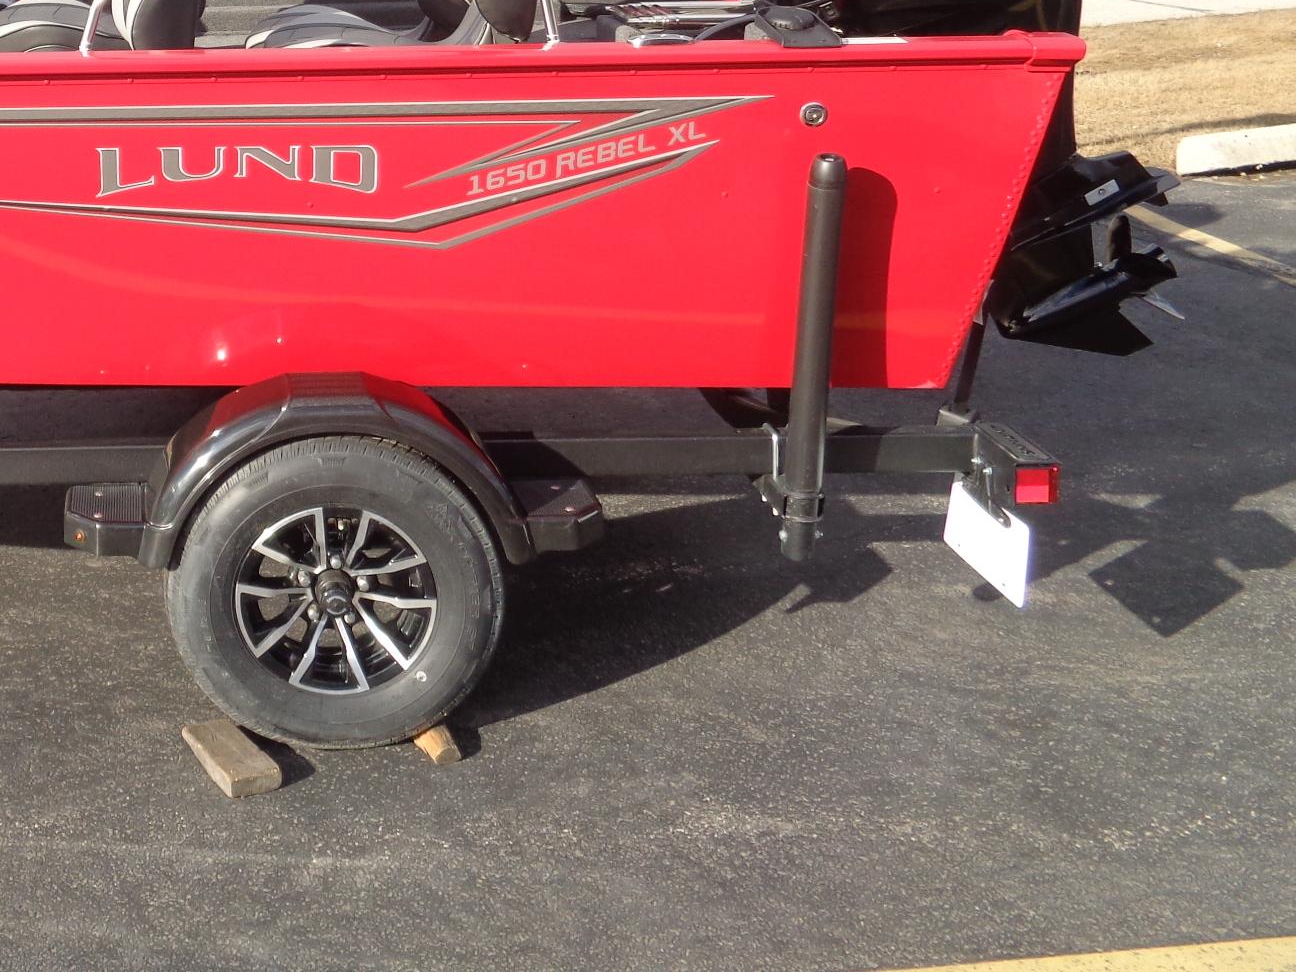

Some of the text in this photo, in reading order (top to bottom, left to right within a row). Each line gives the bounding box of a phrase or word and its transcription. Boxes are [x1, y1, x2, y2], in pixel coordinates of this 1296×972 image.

[96, 145, 378, 197] LUND
[466, 121, 706, 196] 1650 REBEL XL
